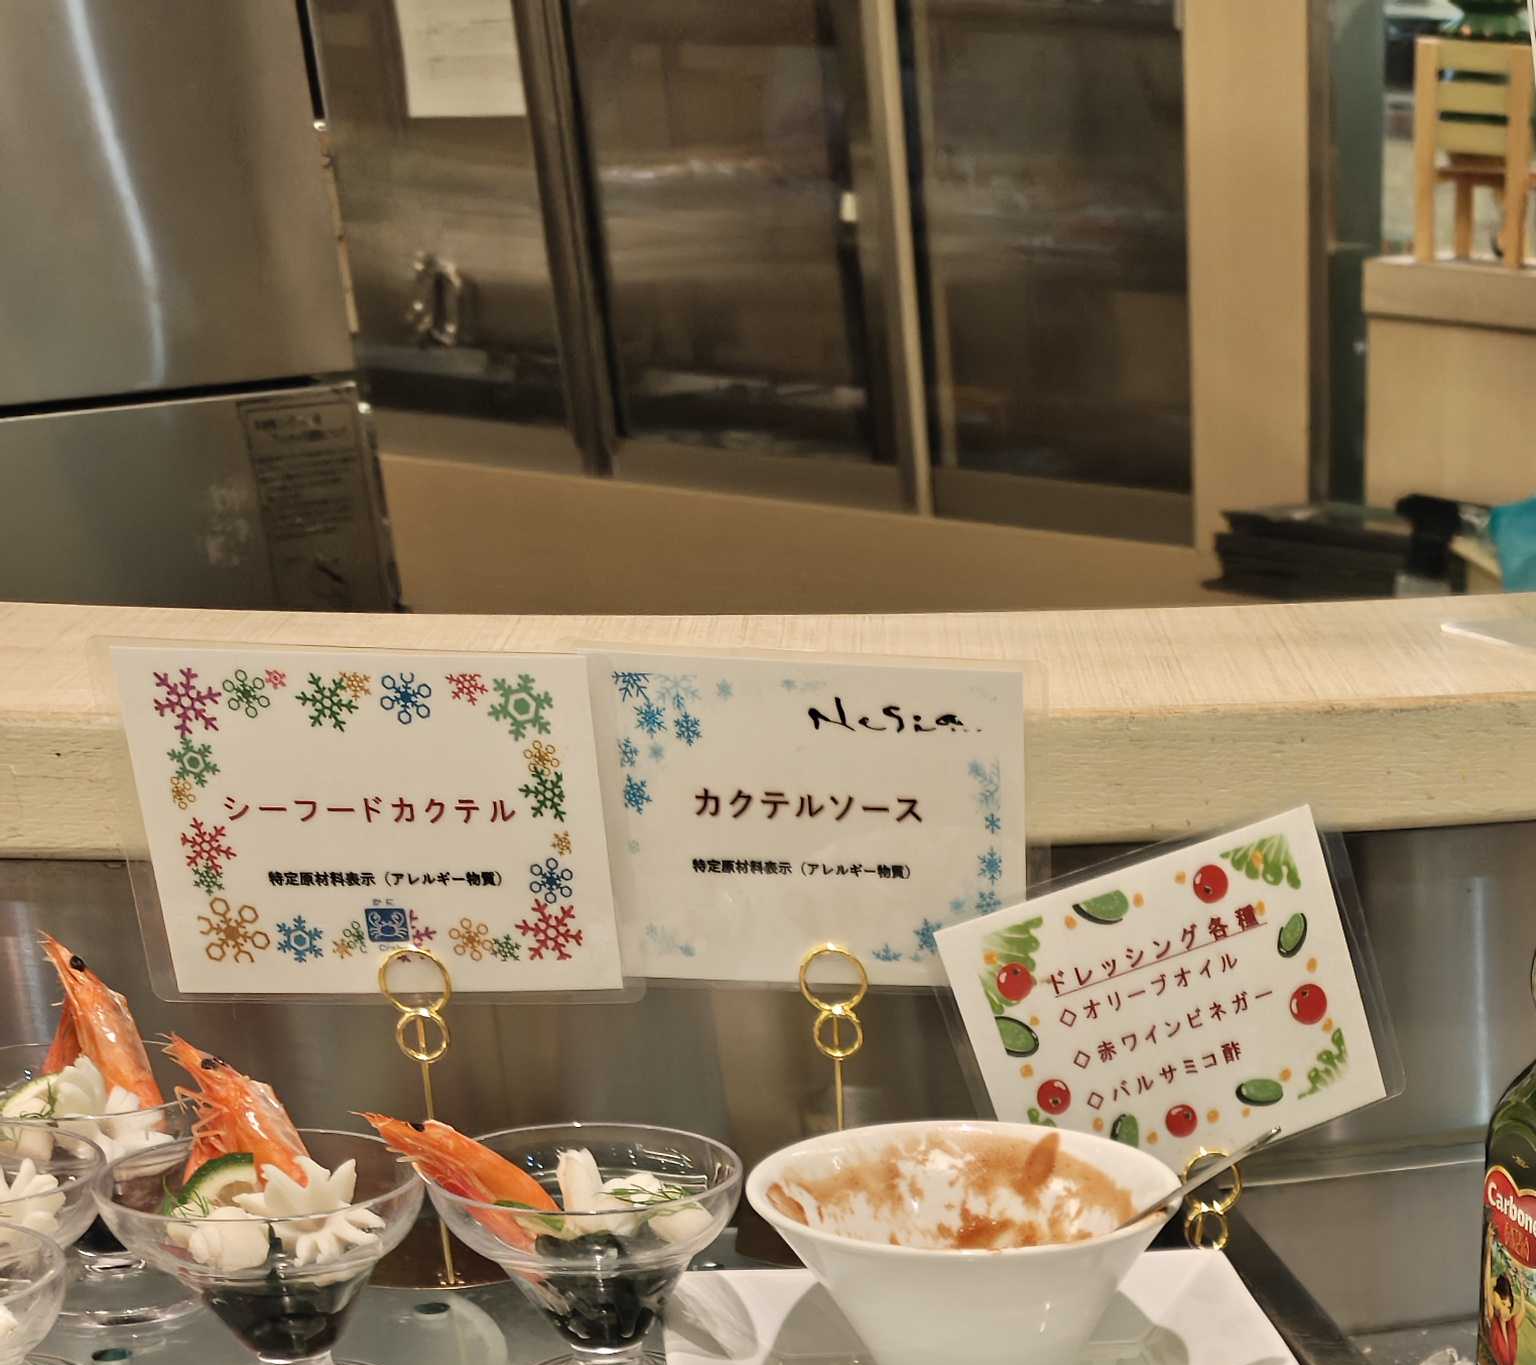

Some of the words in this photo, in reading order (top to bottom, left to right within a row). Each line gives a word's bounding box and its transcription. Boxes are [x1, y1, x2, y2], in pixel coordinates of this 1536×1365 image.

[223, 796, 516, 824] シーフードカクテル
[694, 788, 923, 823] カクテルソース
[1049, 904, 1262, 996] ドレッシング各種
